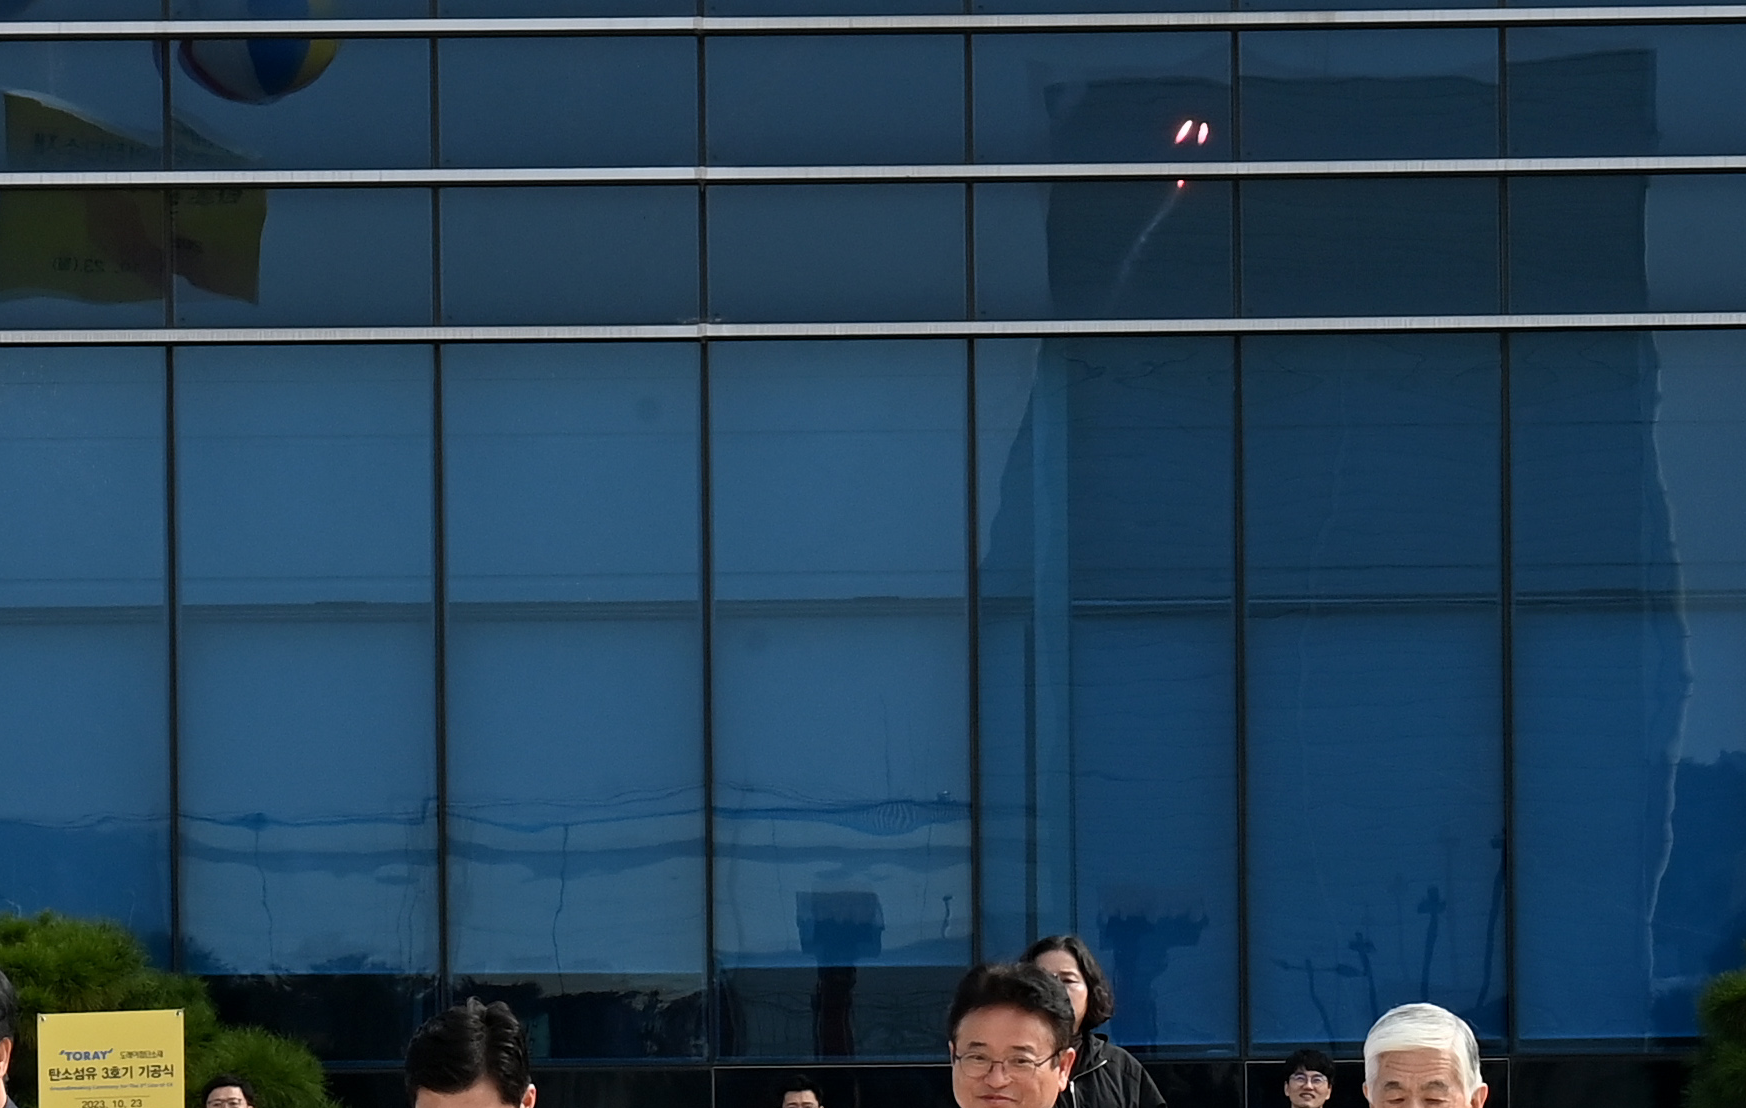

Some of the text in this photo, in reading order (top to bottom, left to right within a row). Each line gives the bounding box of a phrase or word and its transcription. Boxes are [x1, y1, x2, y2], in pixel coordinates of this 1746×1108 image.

[59, 1048, 113, 1061] TORAY
[49, 1064, 174, 1081] 탄소섬유 3호기 기공식
[81, 1099, 143, 1108] 2023. 10. 23
